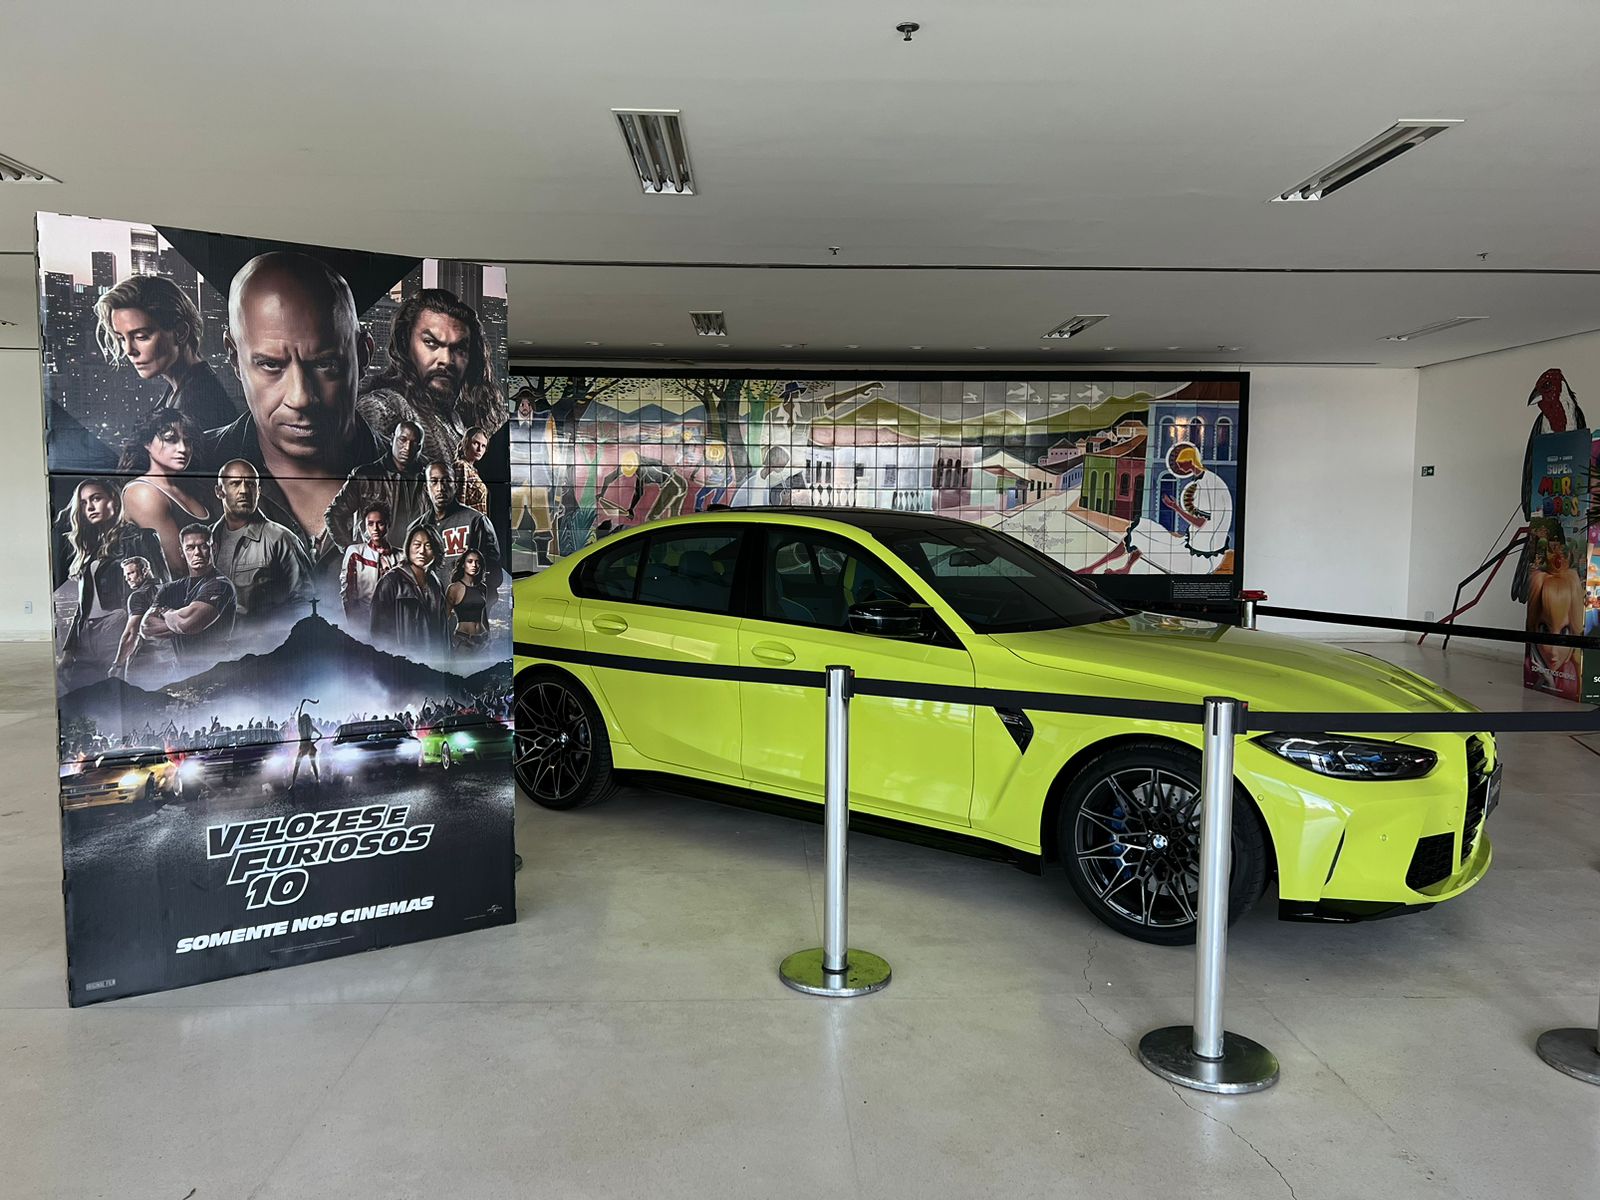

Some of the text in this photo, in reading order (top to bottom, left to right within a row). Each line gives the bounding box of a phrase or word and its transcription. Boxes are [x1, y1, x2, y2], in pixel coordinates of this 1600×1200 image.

[1538, 476, 1588, 496] MARO
[442, 525, 470, 557] W
[207, 804, 411, 859] VELOZES E
[226, 824, 435, 885] FURIOSOS
[245, 869, 309, 910] 10
[176, 920, 289, 953] SOMENTE
[291, 912, 338, 933] NOS
[340, 896, 435, 924] CINEMAS
